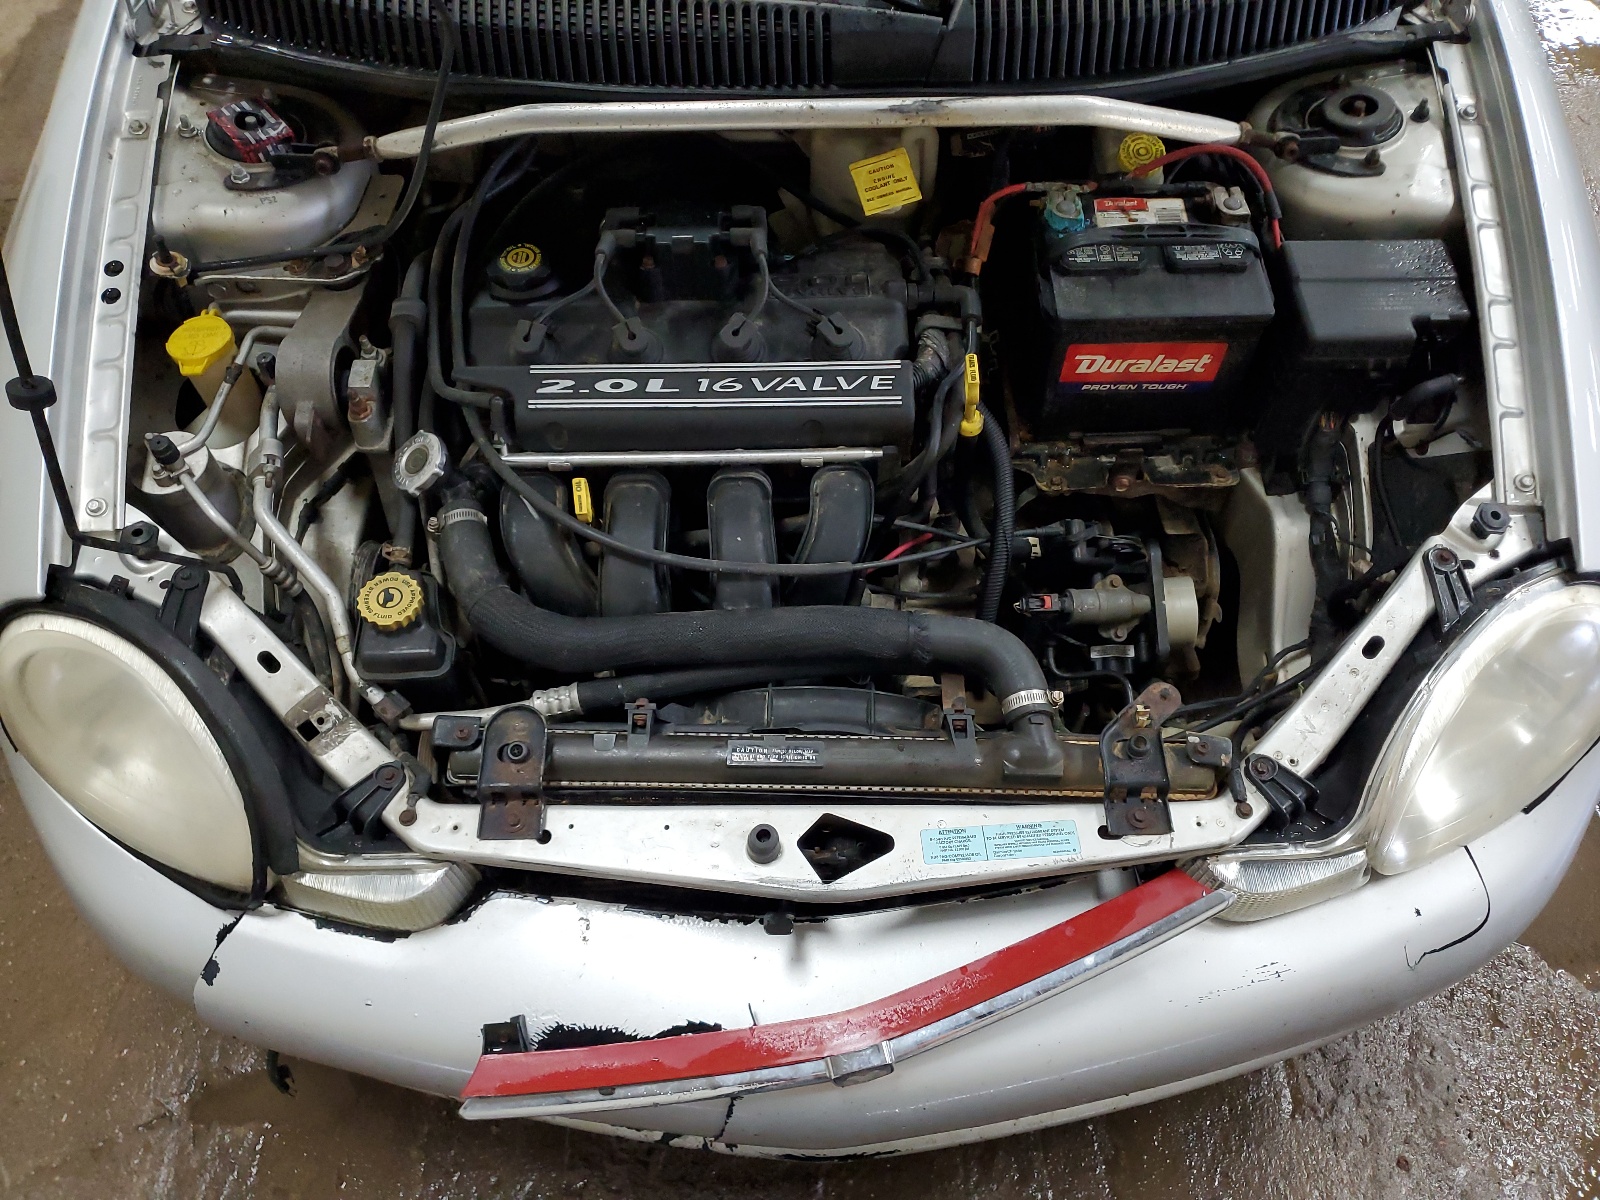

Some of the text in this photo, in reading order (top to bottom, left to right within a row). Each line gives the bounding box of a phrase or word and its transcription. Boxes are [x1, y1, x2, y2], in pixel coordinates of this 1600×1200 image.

[868, 164, 894, 174] CAUTION
[864, 175, 908, 193] COOLANT ONLY
[873, 174, 895, 184] ENGINE
[1074, 353, 1210, 374] Duralast
[535, 375, 897, 394] 2.0L 16 VALVE
[1081, 383, 1188, 391] PROVEN TOUGH
[373, 576, 399, 588] POWER
[363, 586, 374, 614] STEERING
[397, 589, 416, 616] APPROVED
